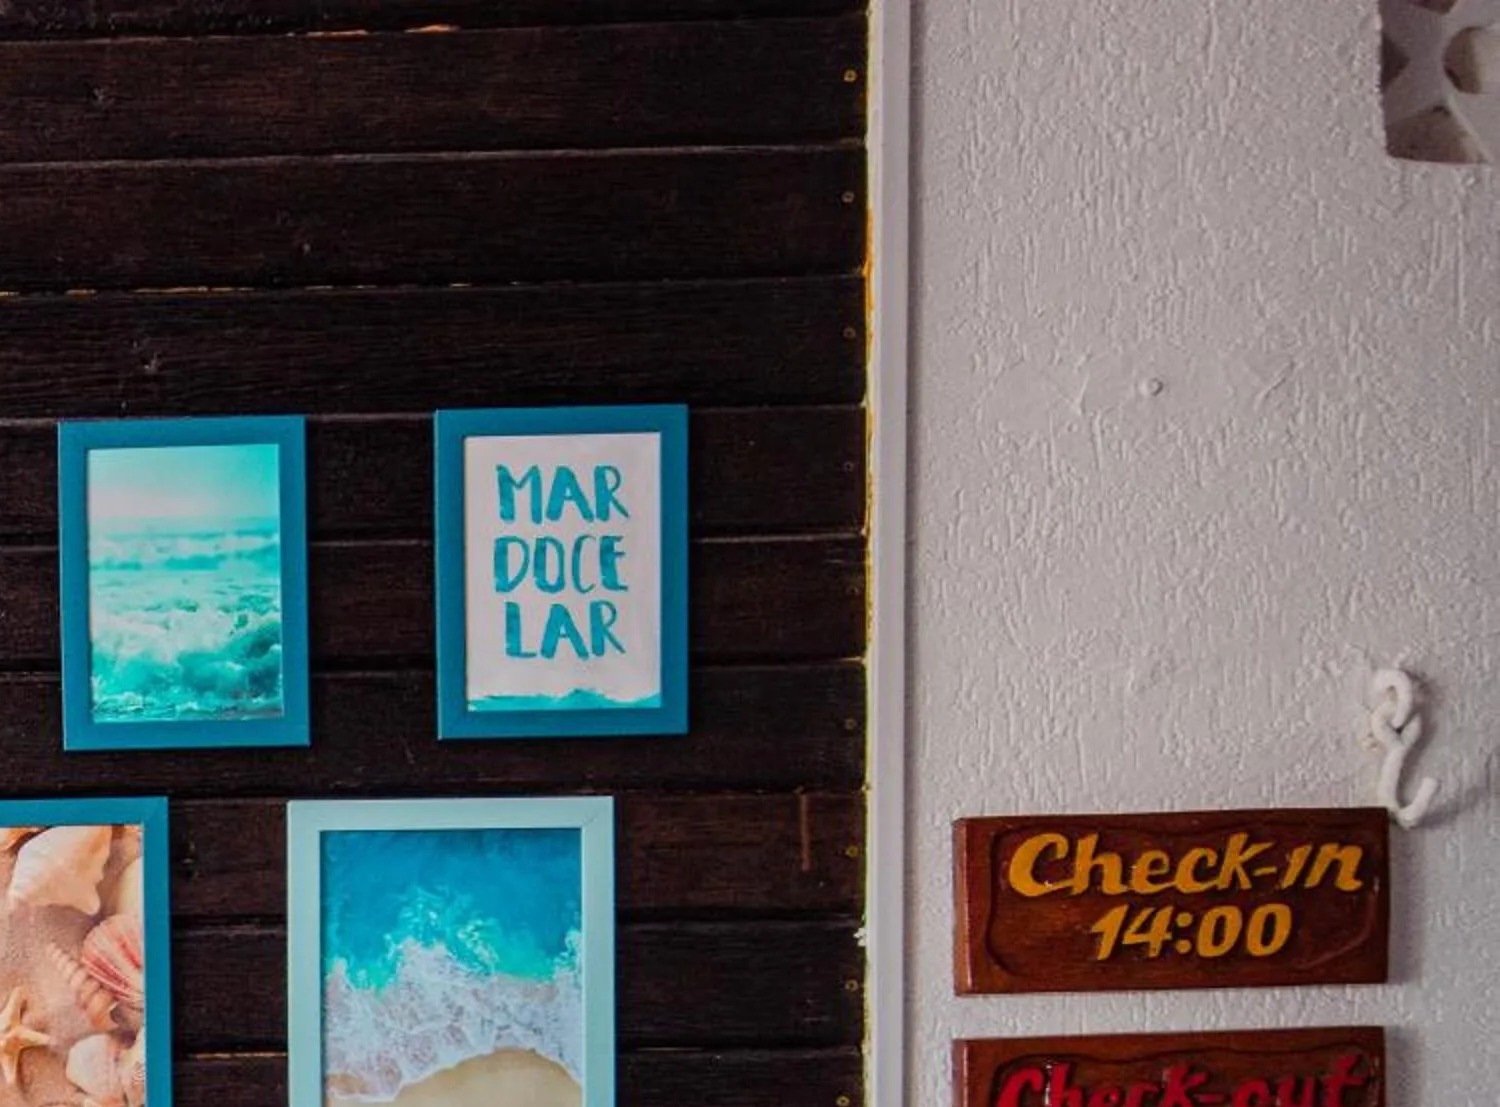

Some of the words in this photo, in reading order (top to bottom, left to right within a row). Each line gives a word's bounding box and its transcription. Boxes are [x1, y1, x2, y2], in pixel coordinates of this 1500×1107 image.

[495, 464, 629, 525] MAR
[493, 535, 629, 594] DOCE
[503, 600, 627, 660] LAR
[1008, 832, 1364, 896] Check-in
[1091, 903, 1293, 960] 14:00
